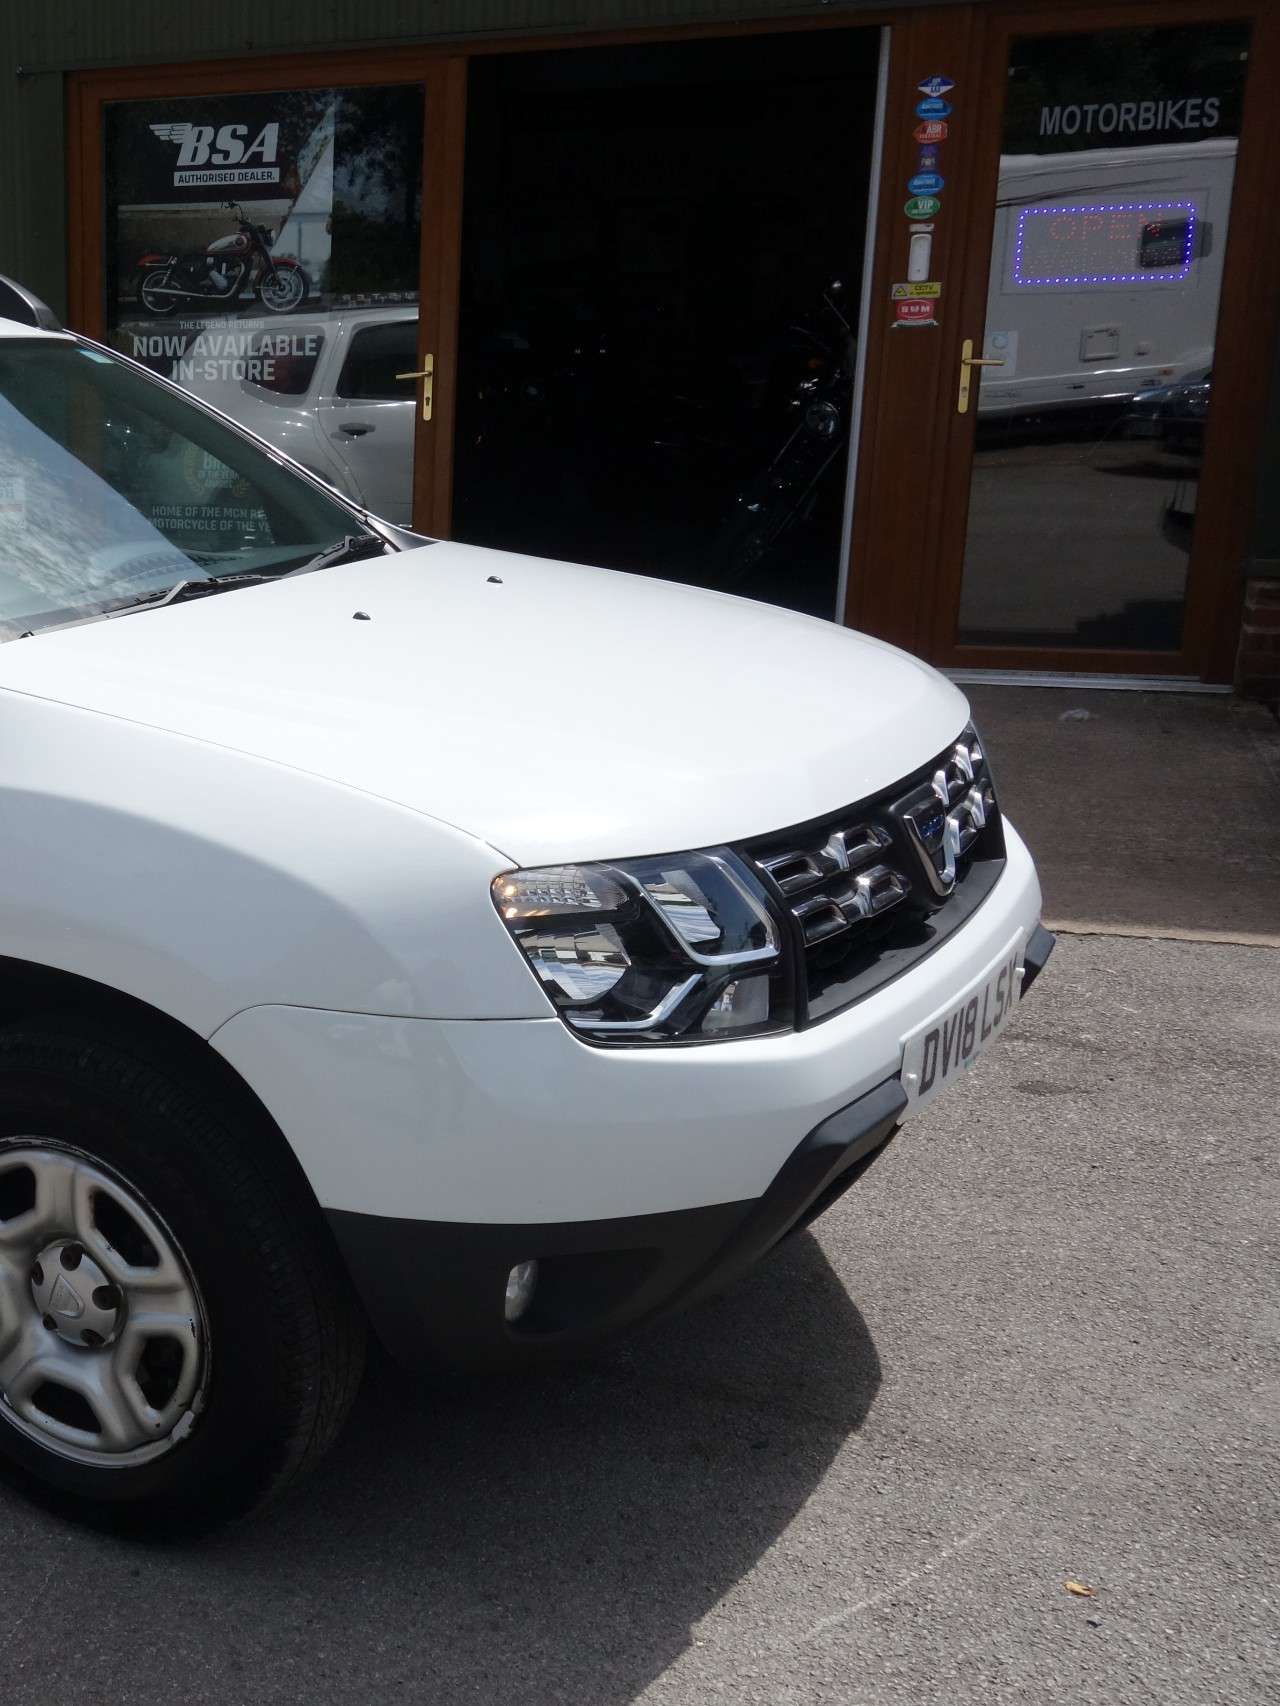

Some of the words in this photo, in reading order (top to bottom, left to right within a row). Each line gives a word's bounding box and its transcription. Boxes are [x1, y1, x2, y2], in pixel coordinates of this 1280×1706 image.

[1039, 97, 1221, 135] MOTORBIKES
[175, 122, 280, 167] BSA
[178, 172, 235, 184] AUTHORISED
[179, 320, 194, 329] THE
[133, 335, 187, 358] NOW
[192, 334, 318, 357] AVAILABLE
[171, 359, 276, 381] IN-STORE
[152, 505, 183, 516] HOME
[185, 506, 198, 517] OF
[200, 506, 221, 518] THE
[220, 520, 233, 530] OF
